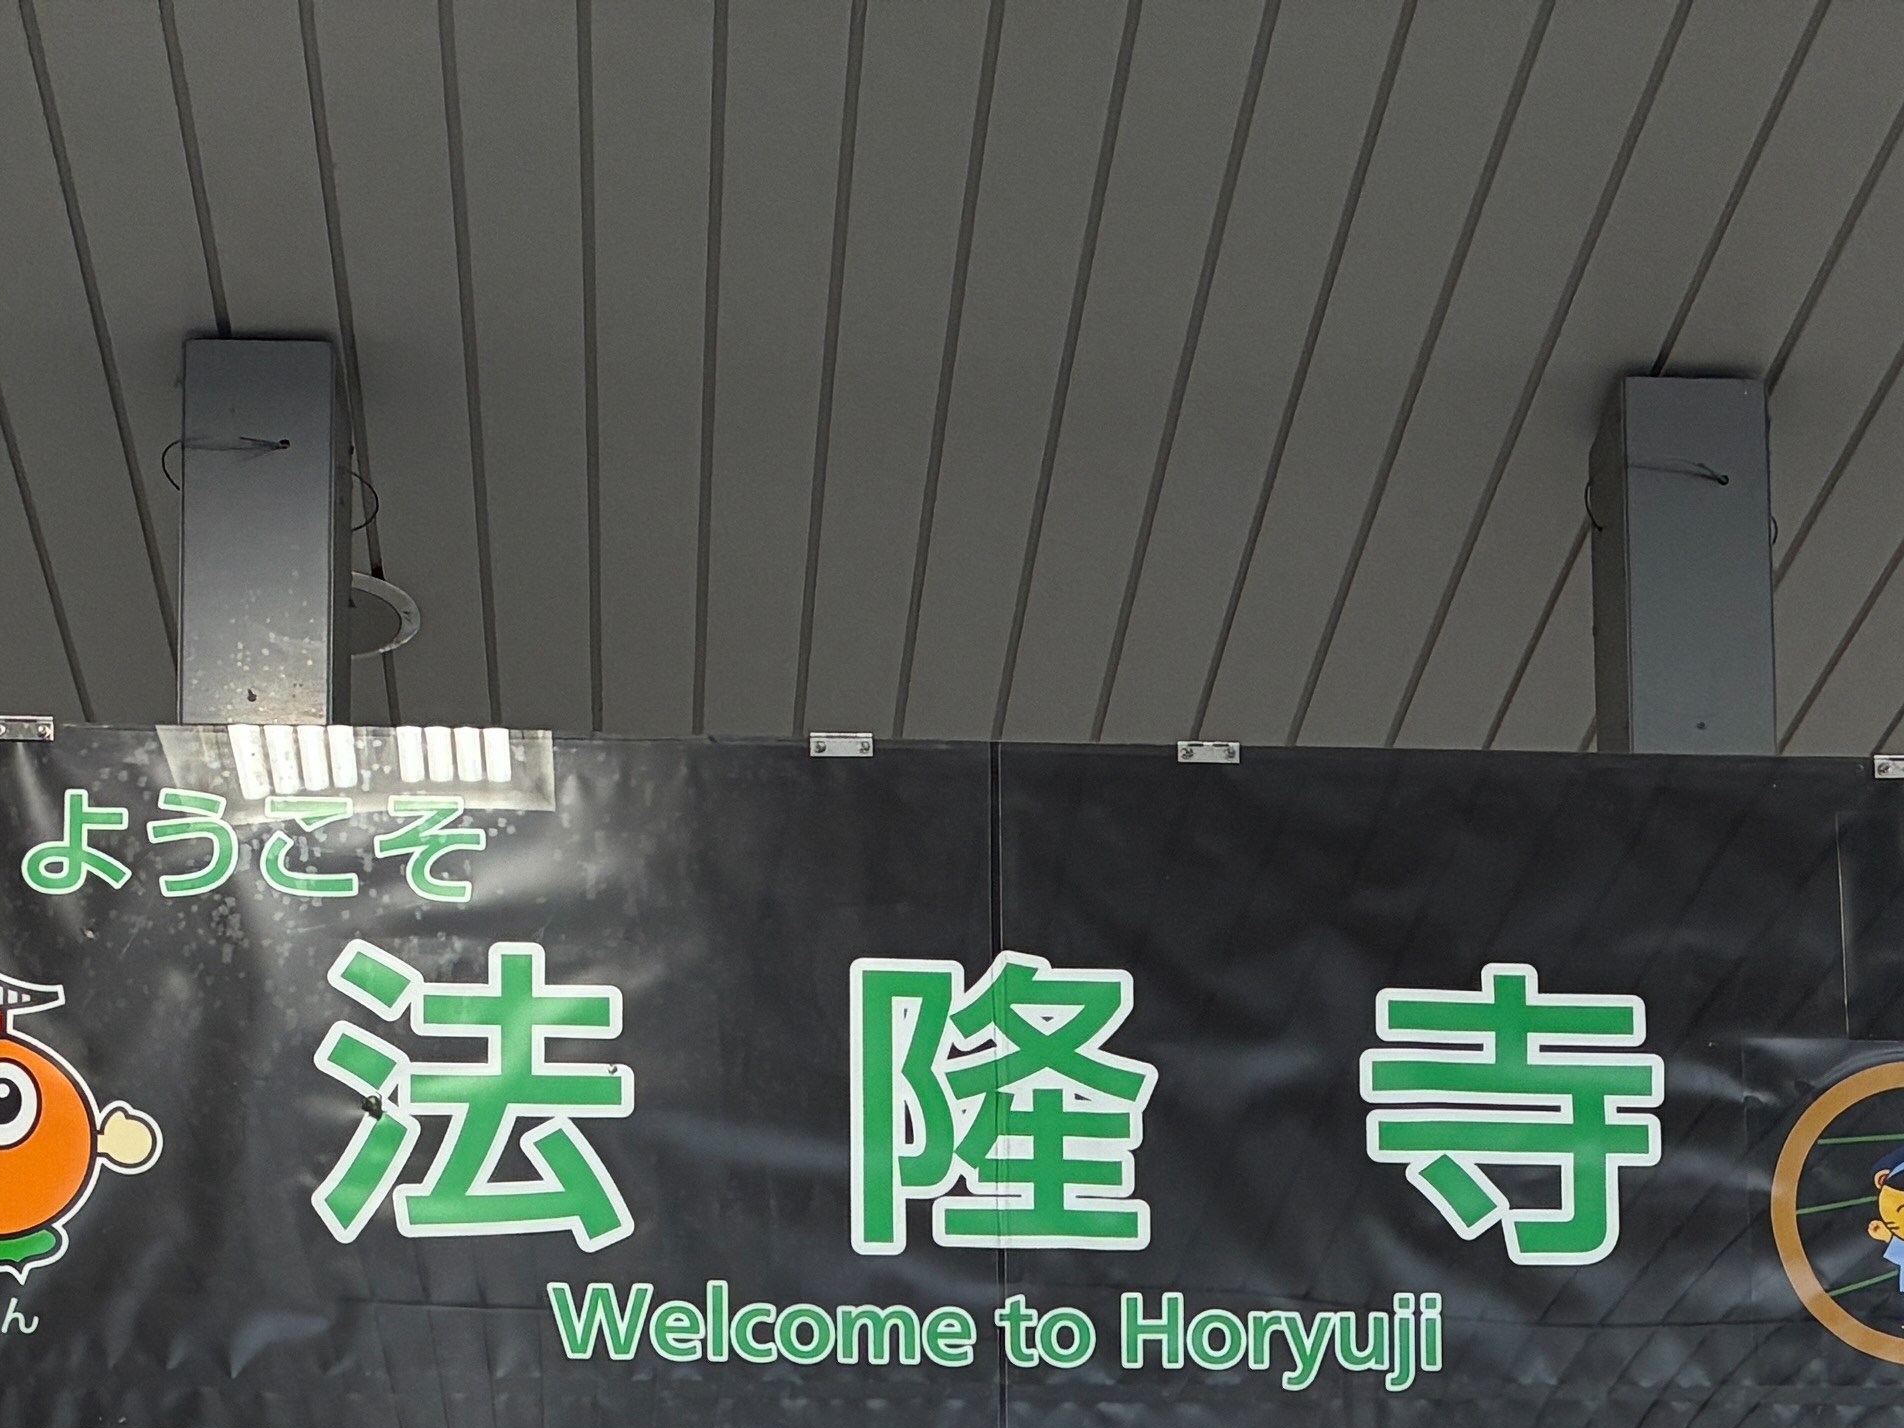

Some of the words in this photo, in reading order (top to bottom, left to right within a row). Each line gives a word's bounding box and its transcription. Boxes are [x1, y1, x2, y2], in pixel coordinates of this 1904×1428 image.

[19, 785, 490, 903] ようこそ
[310, 938, 1666, 1266] 法隆寺
[548, 1280, 975, 1369] Welcome
[998, 1291, 1096, 1370] to
[1120, 1293, 1442, 1391] Horyuji
